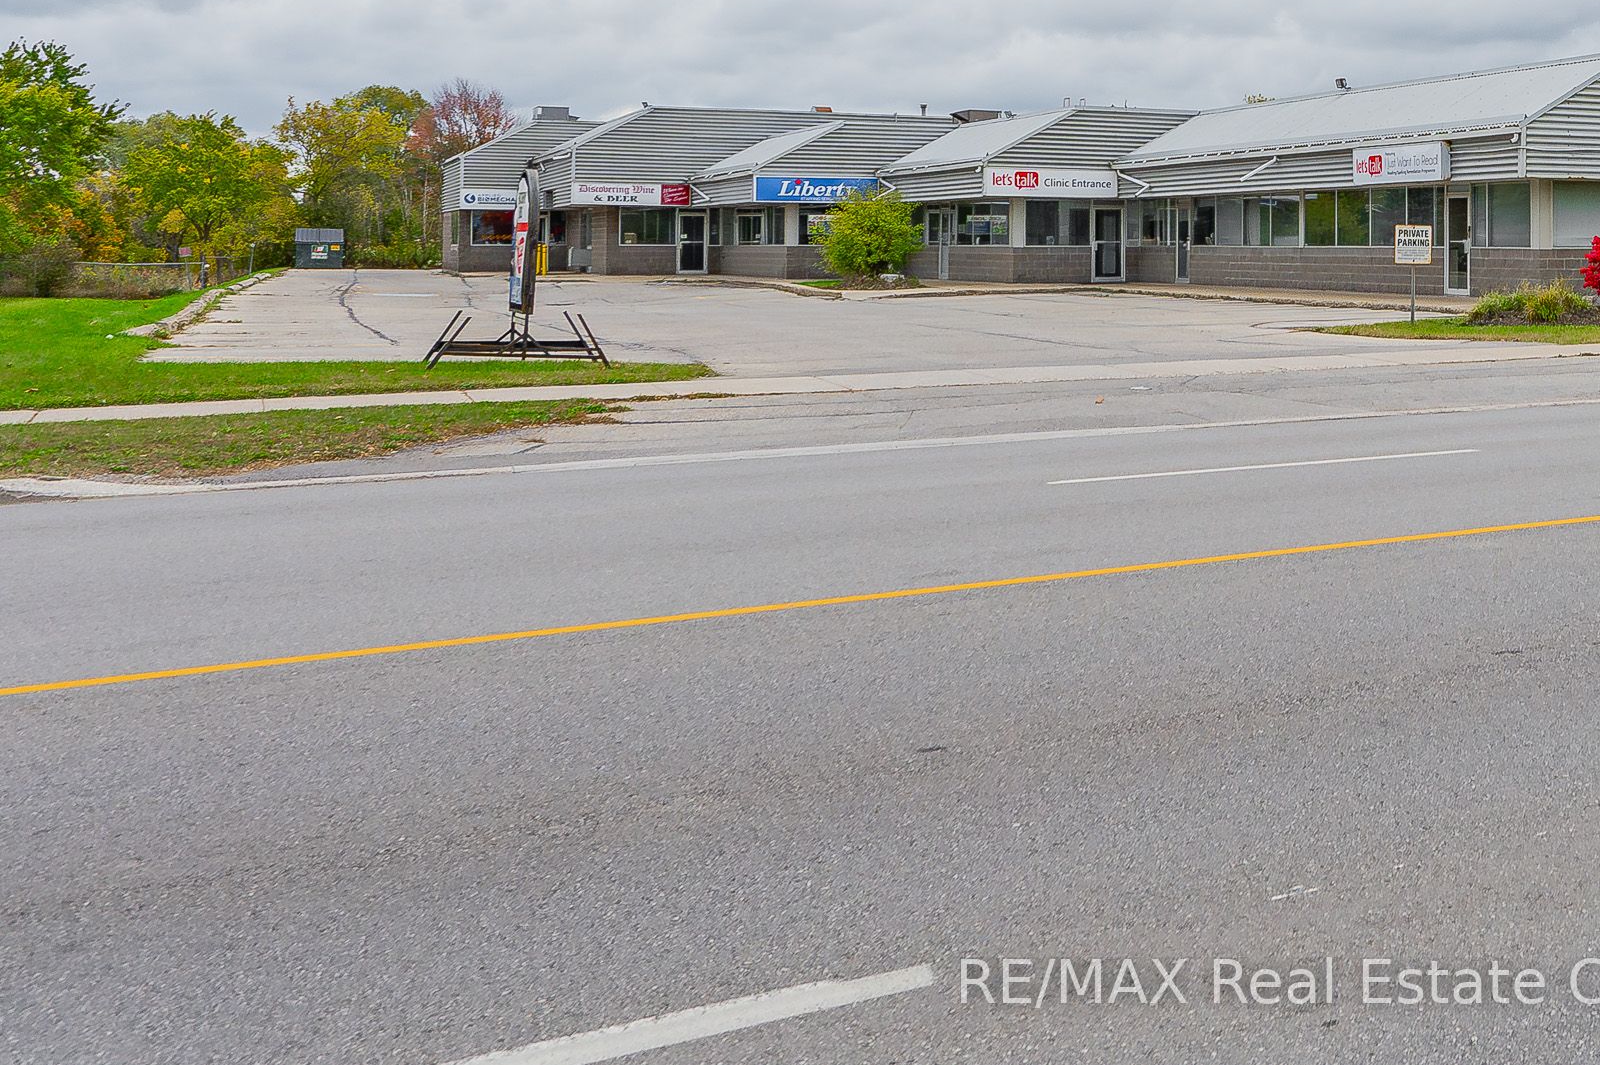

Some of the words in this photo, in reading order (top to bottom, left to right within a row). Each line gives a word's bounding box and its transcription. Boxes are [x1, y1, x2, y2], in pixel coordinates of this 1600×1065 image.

[1355, 158, 1368, 174] let's
[1369, 156, 1383, 174] talk
[1412, 155, 1421, 167] To
[992, 172, 1013, 186] let's
[1015, 172, 1038, 188] talk
[1043, 178, 1070, 188] Clinic
[1071, 179, 1112, 188] Entrance
[578, 184, 630, 194] Discovering
[632, 184, 655, 194] Wine
[777, 179, 858, 200] Liberty
[607, 195, 638, 203] BEER
[1398, 229, 1430, 238] PRIVATE
[1397, 238, 1430, 247] PARKING
